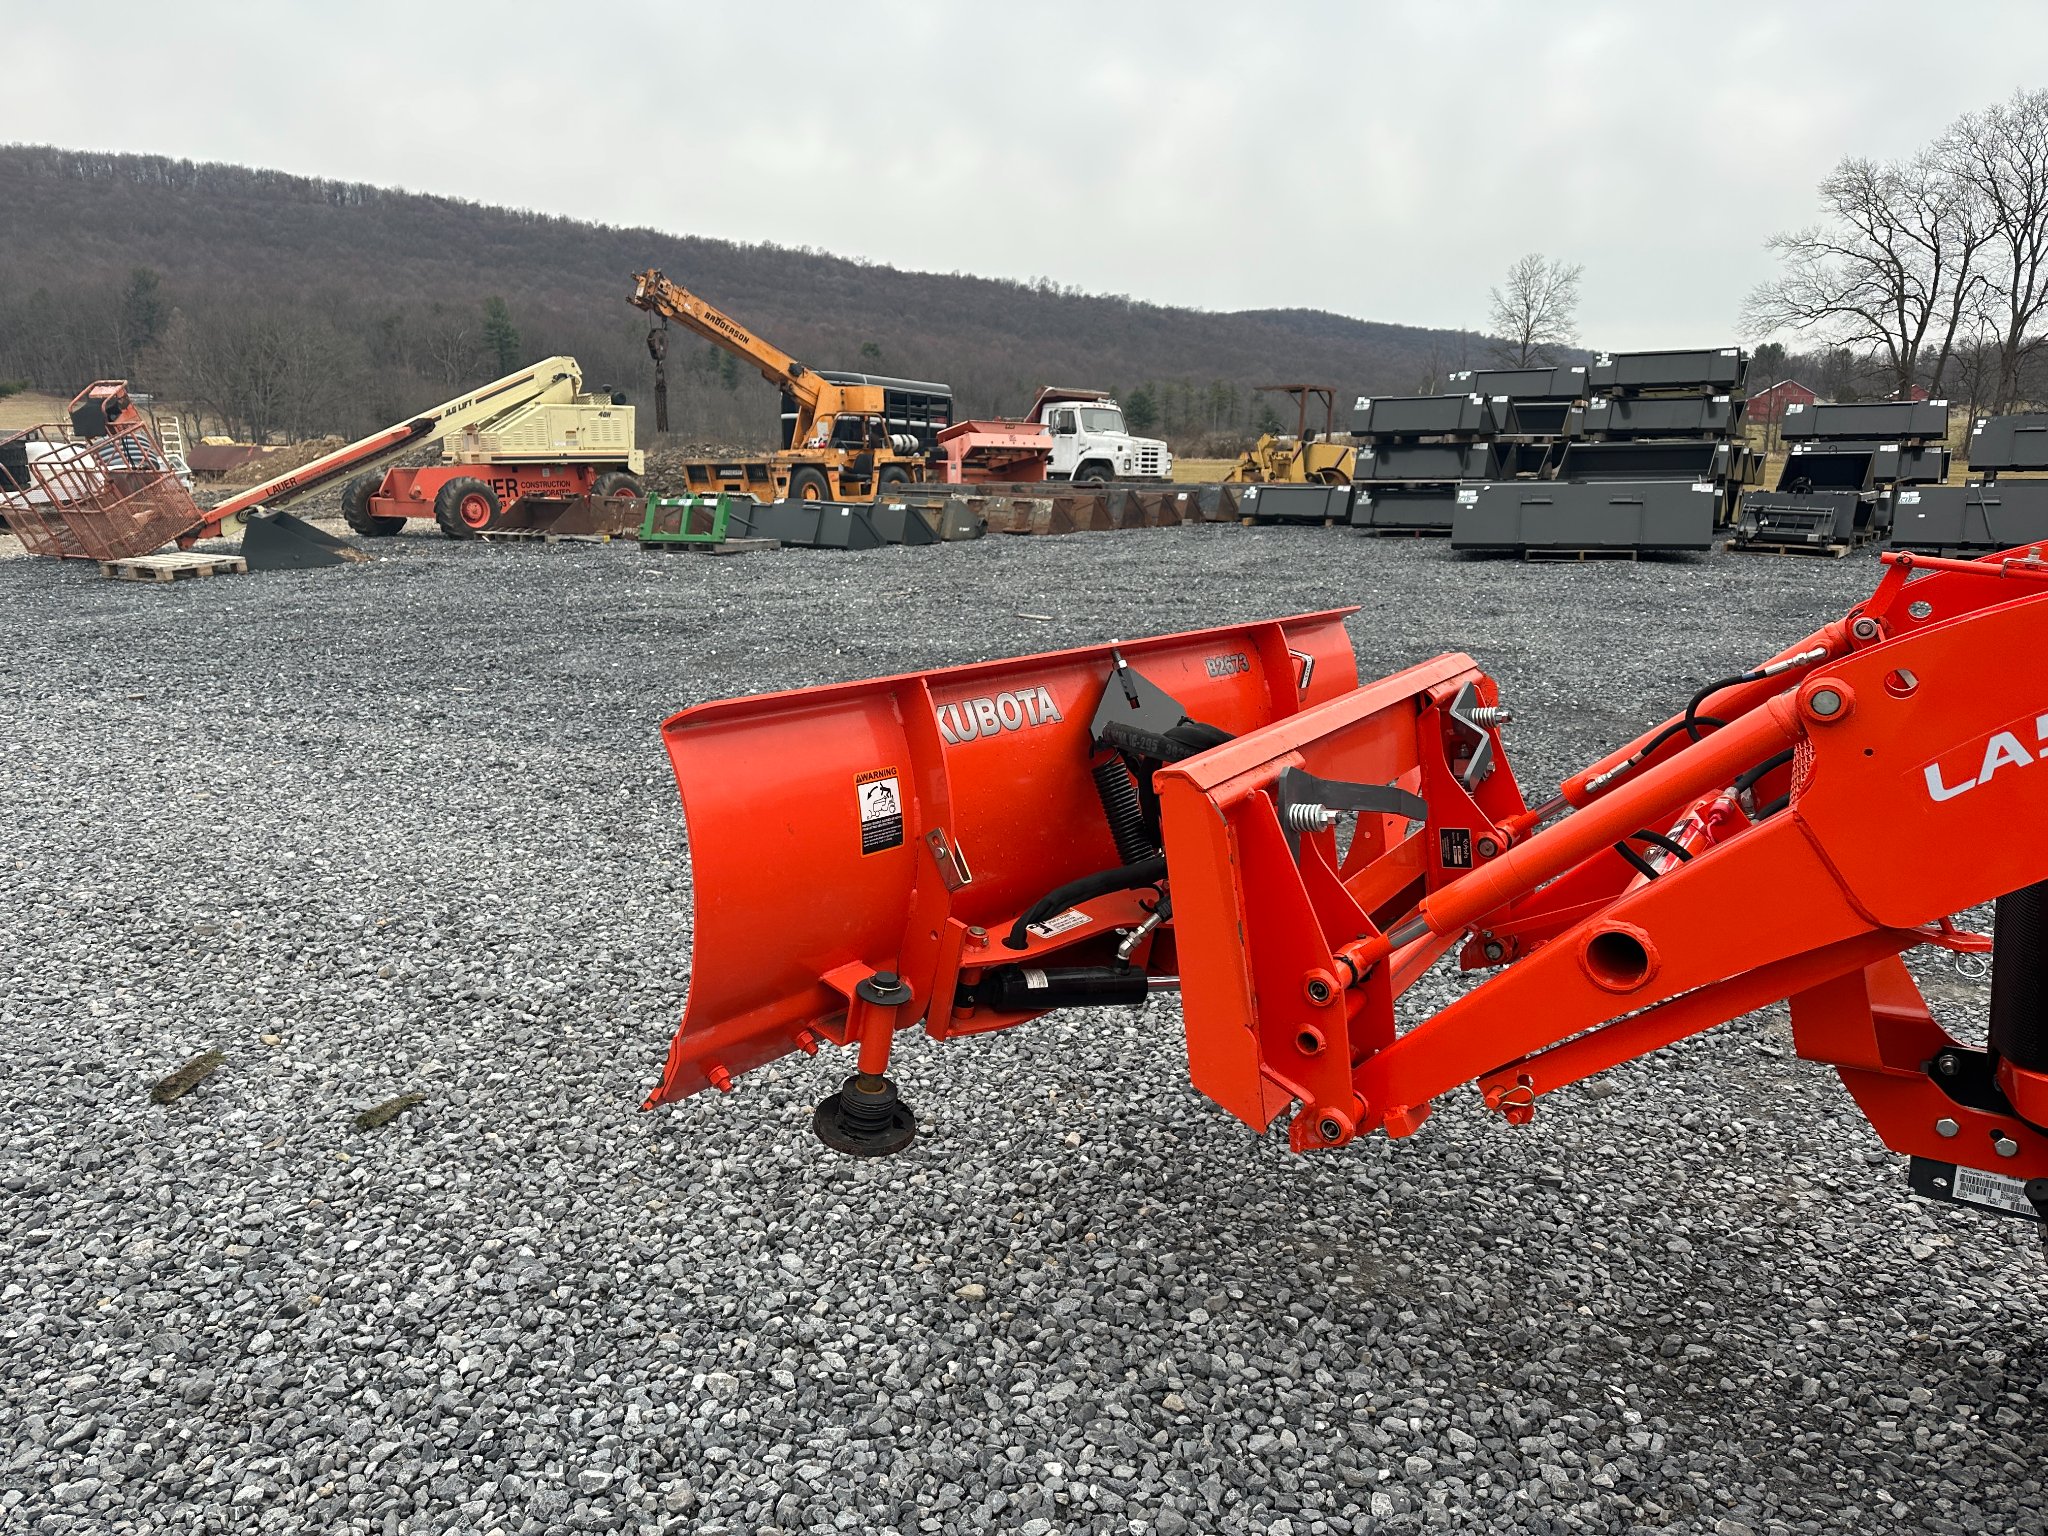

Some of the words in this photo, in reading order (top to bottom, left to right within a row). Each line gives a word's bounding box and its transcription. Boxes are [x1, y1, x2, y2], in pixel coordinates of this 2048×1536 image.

[704, 311, 750, 345] BRODERSON
[445, 406, 457, 418] JLG
[458, 399, 472, 411] LIFT
[265, 476, 299, 498] LAUER
[520, 480, 571, 489] CONSTRUCTION
[1205, 653, 1250, 678] B2673
[936, 686, 1062, 745] KUBOTA
[1924, 713, 2048, 802] LA
[861, 767, 897, 781] WARNING
